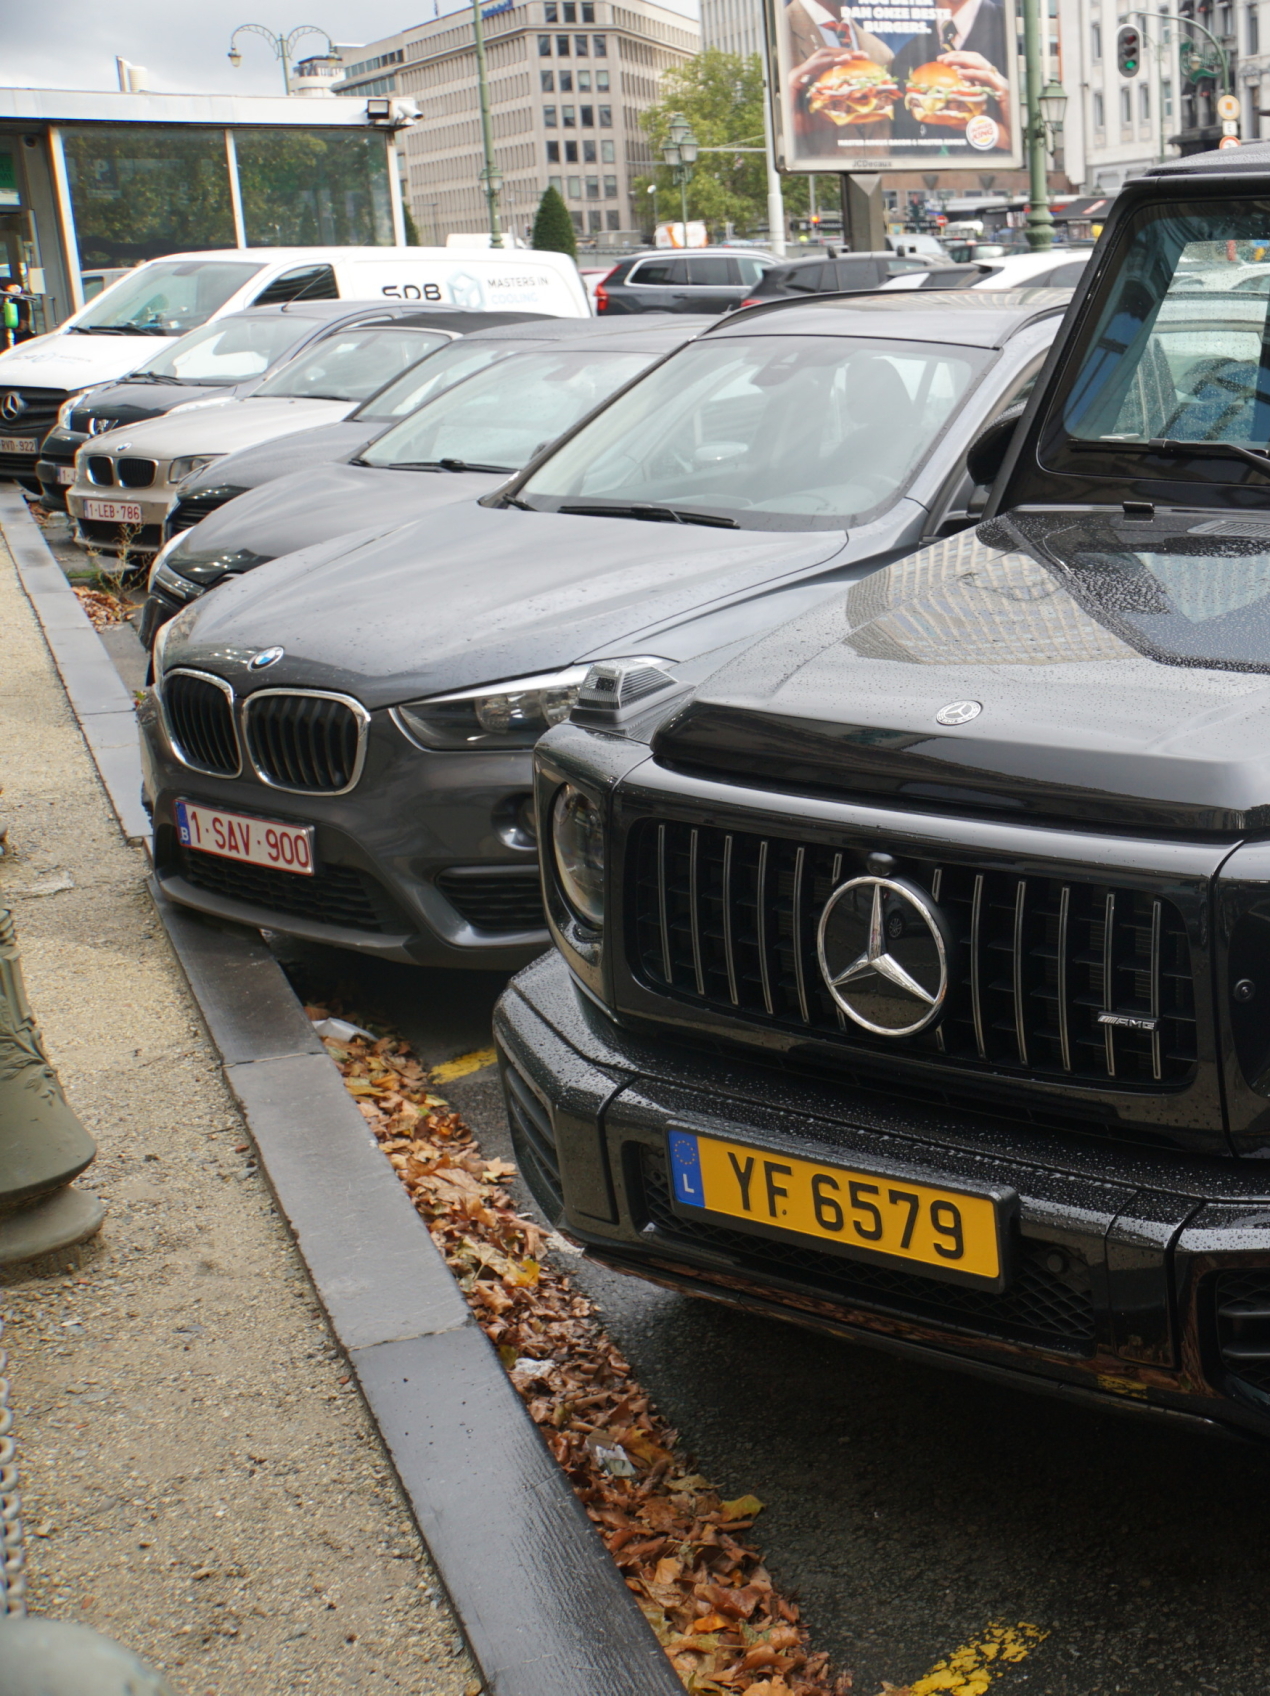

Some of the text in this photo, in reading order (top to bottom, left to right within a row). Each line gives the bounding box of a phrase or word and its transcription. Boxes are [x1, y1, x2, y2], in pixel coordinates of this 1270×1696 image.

[840, 6, 952, 20] DAN ONZE BESTE
[863, 20, 932, 34] BURGERS.
[852, 159, 892, 168] JCDecaux
[487, 276, 549, 288] MASTERS IN
[682, 1173, 695, 1194] L
[811, 1172, 965, 1260] 6579
